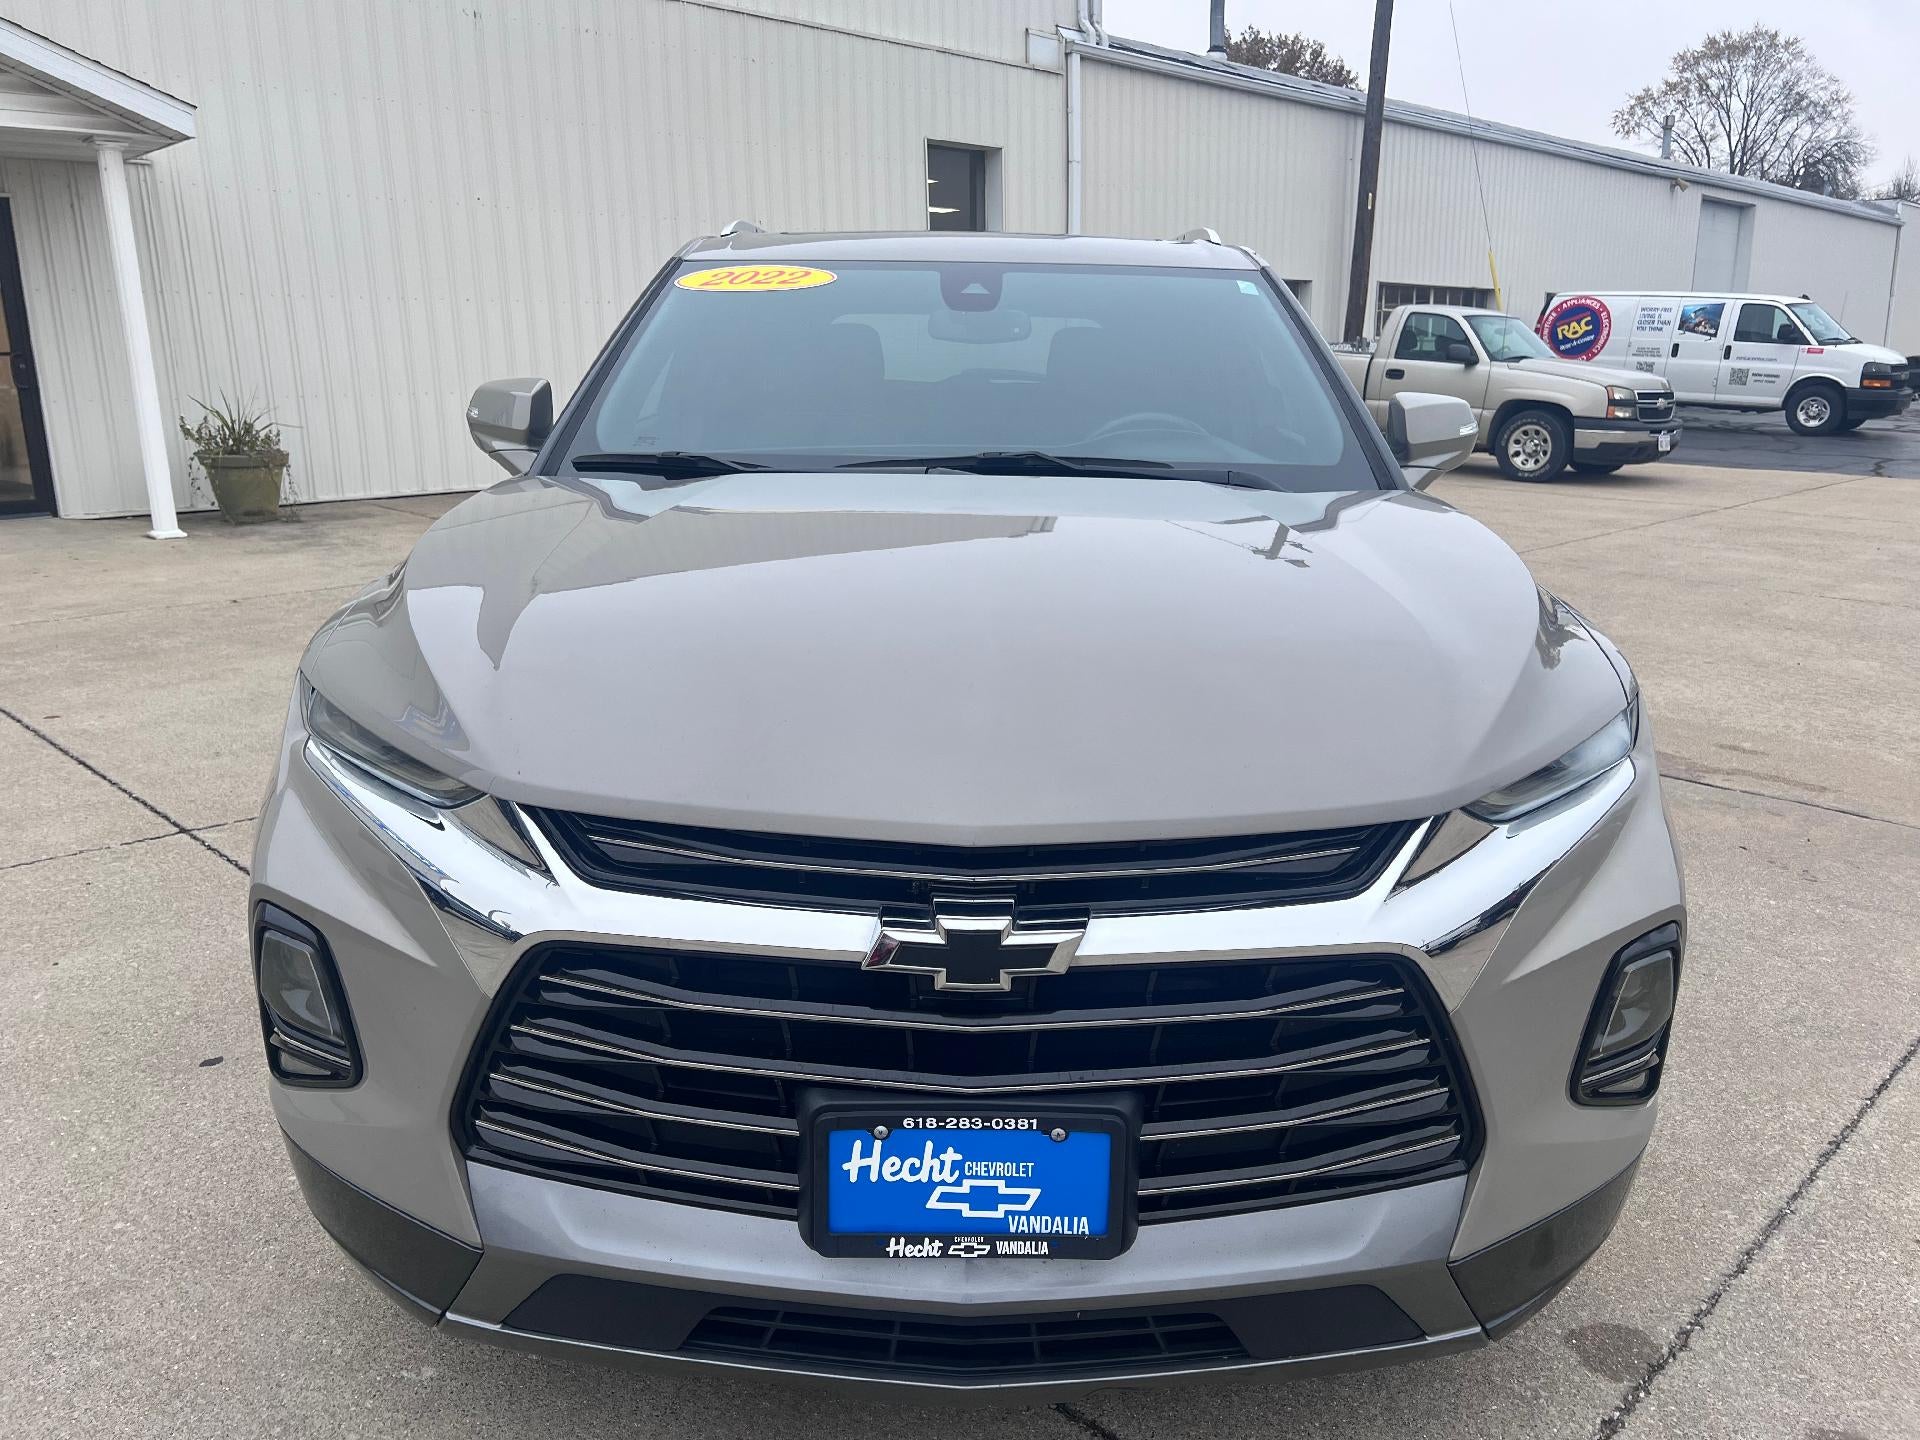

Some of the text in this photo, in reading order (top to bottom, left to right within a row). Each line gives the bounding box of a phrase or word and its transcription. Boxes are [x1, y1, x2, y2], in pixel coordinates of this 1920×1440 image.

[699, 270, 812, 287] 2022
[1557, 316, 1593, 340] RAC
[903, 1117, 1038, 1130] 618-283-0381
[842, 1139, 1034, 1183] Hecht CHEVROLET
[1008, 1215, 1089, 1235] VANDALIA
[886, 1236, 1049, 1258] Hecht VANDALIA
